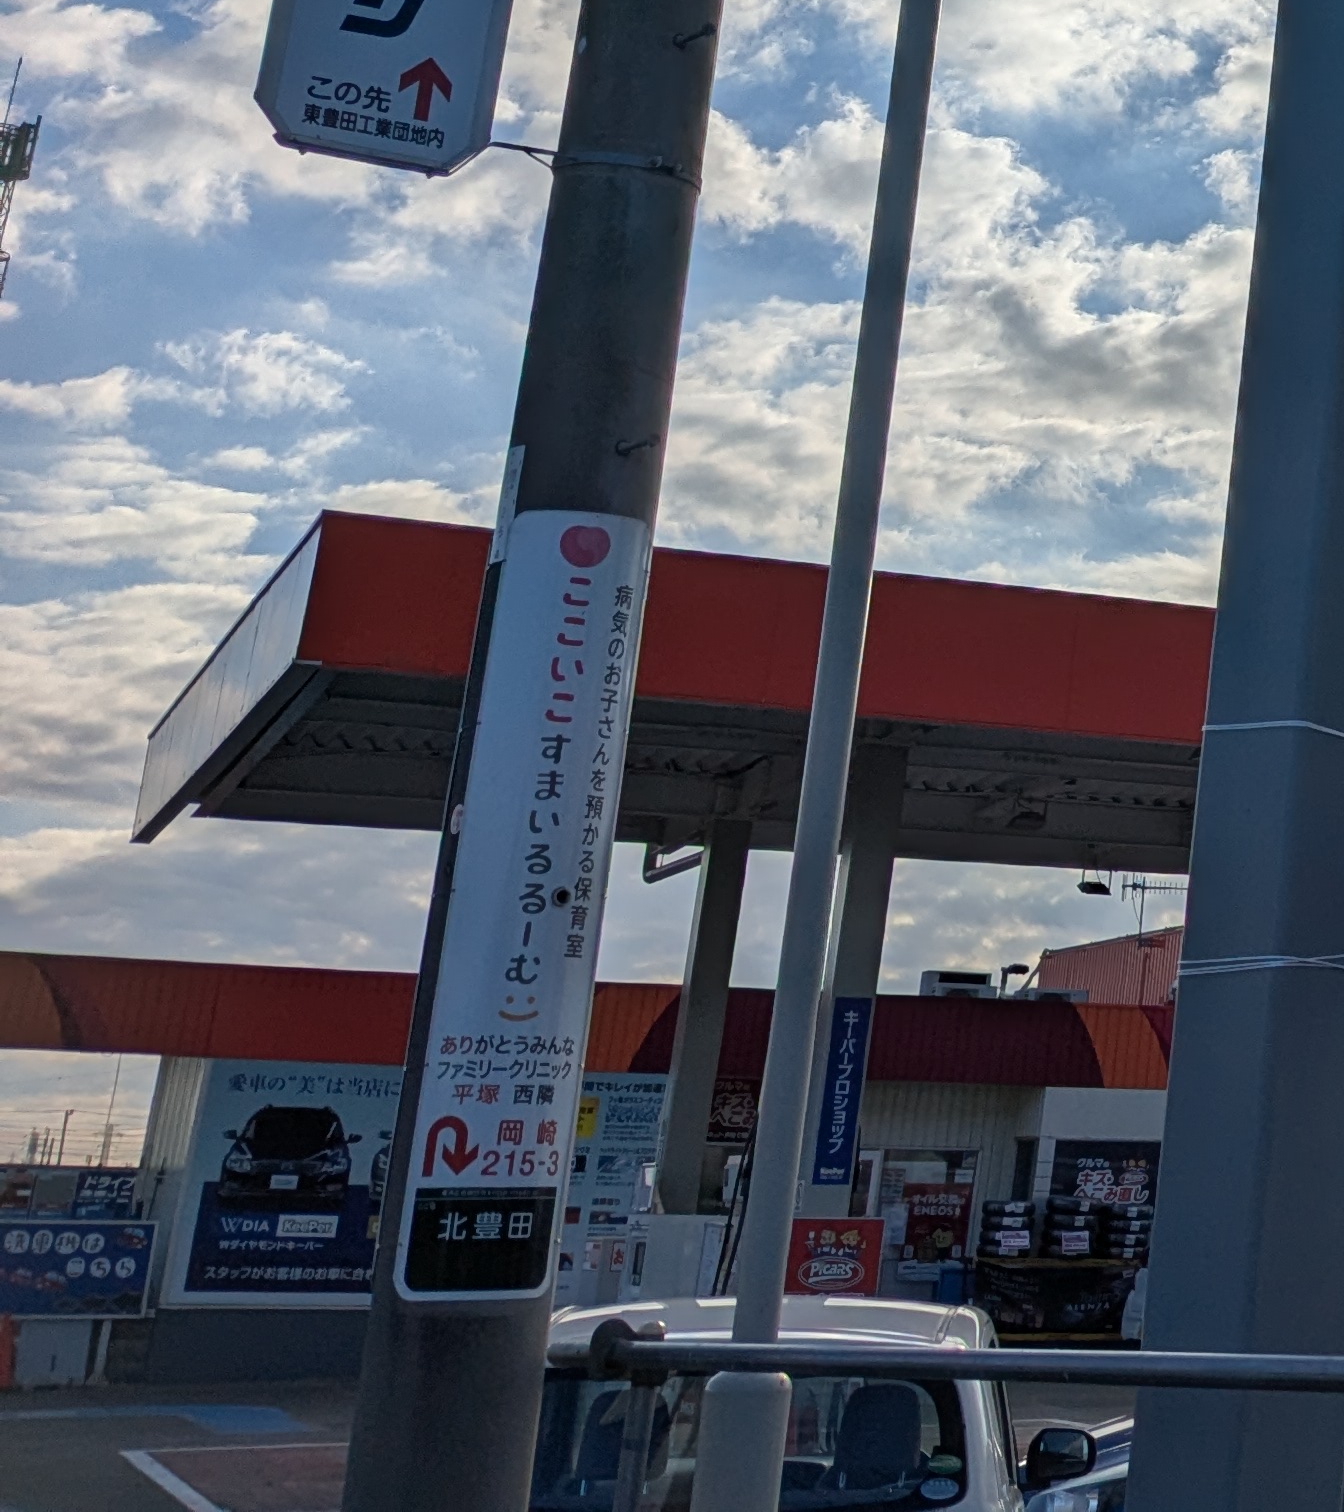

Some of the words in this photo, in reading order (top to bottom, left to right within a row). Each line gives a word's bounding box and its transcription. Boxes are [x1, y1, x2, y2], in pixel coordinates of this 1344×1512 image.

[306, 75, 392, 114] この先
[302, 103, 446, 150] 東豊田工業団地内
[563, 584, 634, 959] 病気のお子さんを預かる保育室
[439, 1035, 575, 1056] ありがとうみんな
[437, 1059, 573, 1080] ファミリークリニック
[451, 1083, 501, 1105] 平塚
[480, 1149, 560, 1177] 215-3
[437, 1211, 533, 1240] 北豊田
